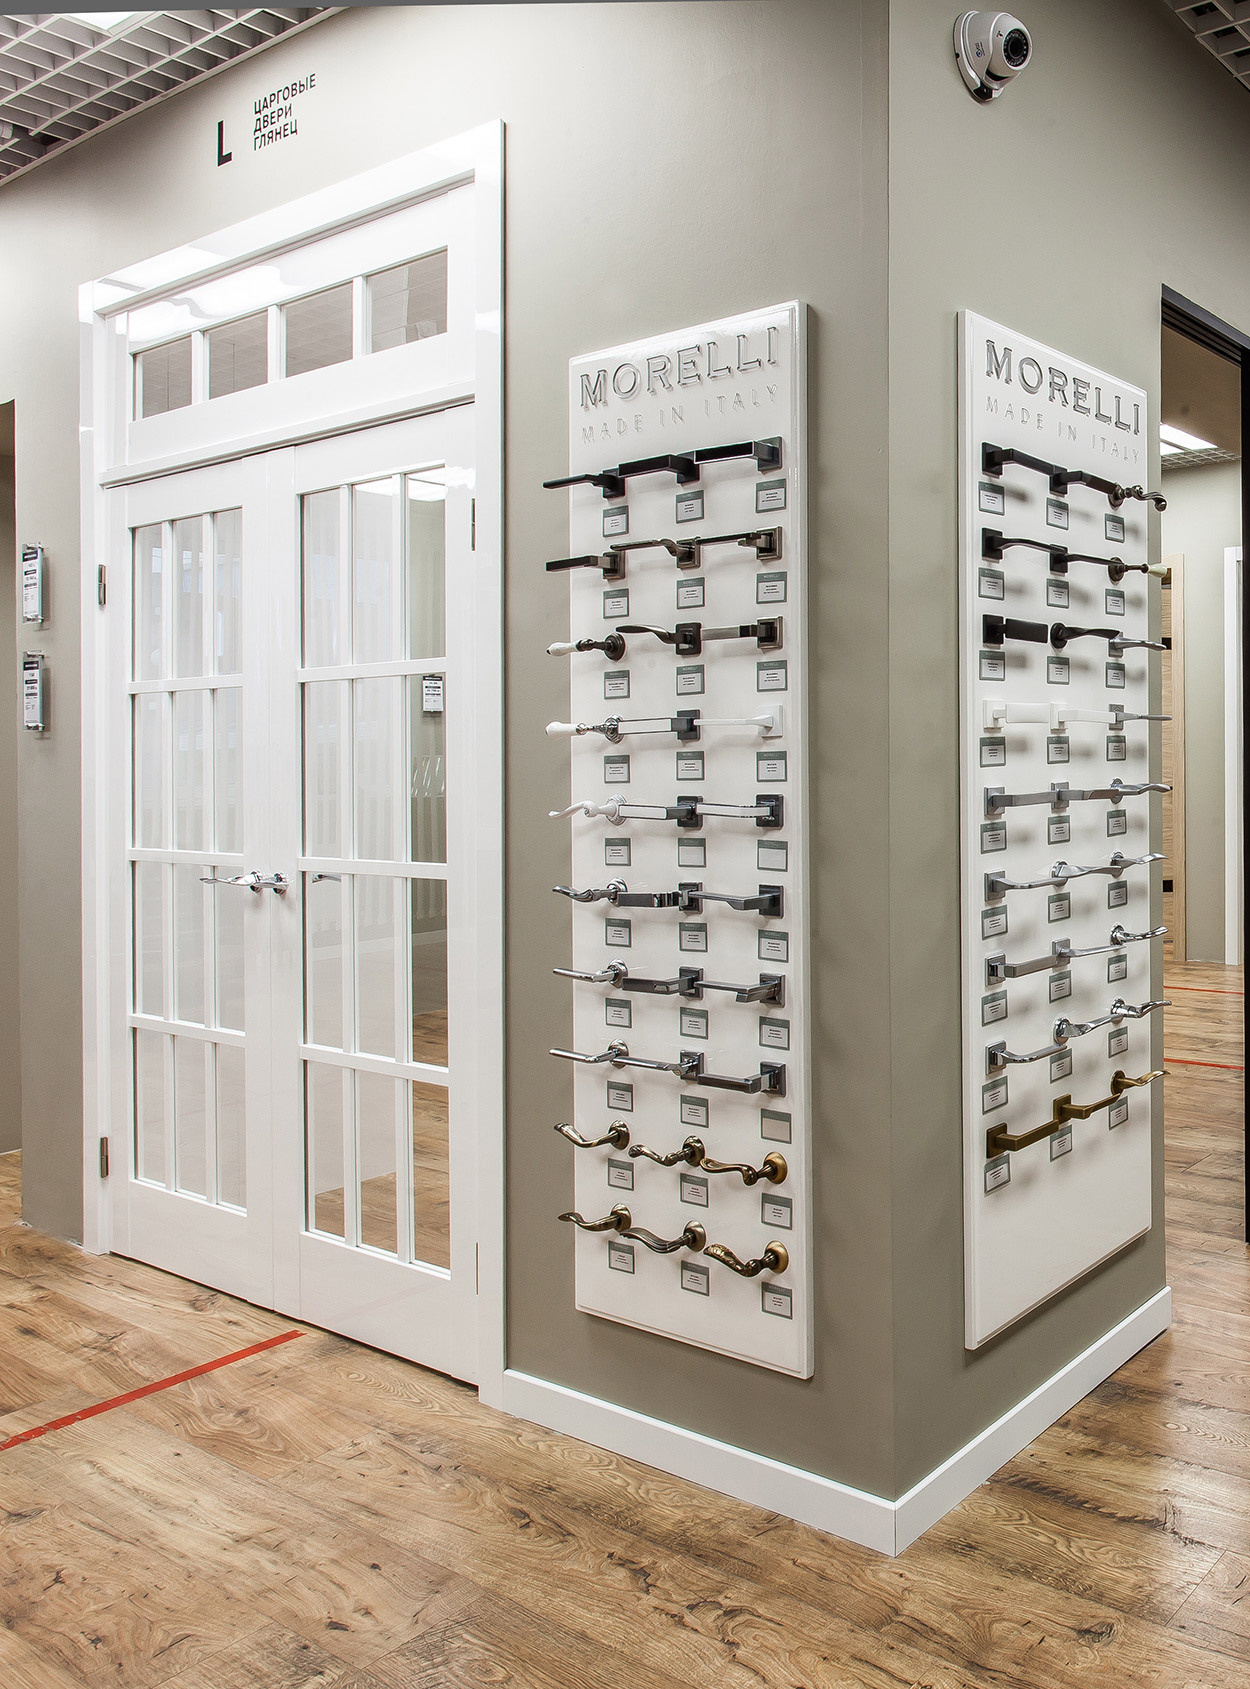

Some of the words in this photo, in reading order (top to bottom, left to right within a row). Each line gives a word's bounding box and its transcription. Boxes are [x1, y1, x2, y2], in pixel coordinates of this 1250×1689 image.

[253, 73, 316, 115] ЦАРГОВЫЕ
[253, 103, 293, 135] ДВЕРИ
[217, 120, 233, 167] L
[253, 119, 298, 151] ГЛЯНЕЦ
[579, 326, 779, 410] MORELLI
[985, 339, 1140, 435] MORELLI
[581, 413, 644, 444] MADE
[658, 405, 684, 428] IN
[704, 384, 778, 417] ITALY
[985, 395, 1044, 431] MADE
[1057, 421, 1078, 442] IN
[1091, 434, 1140, 465] ITALY
